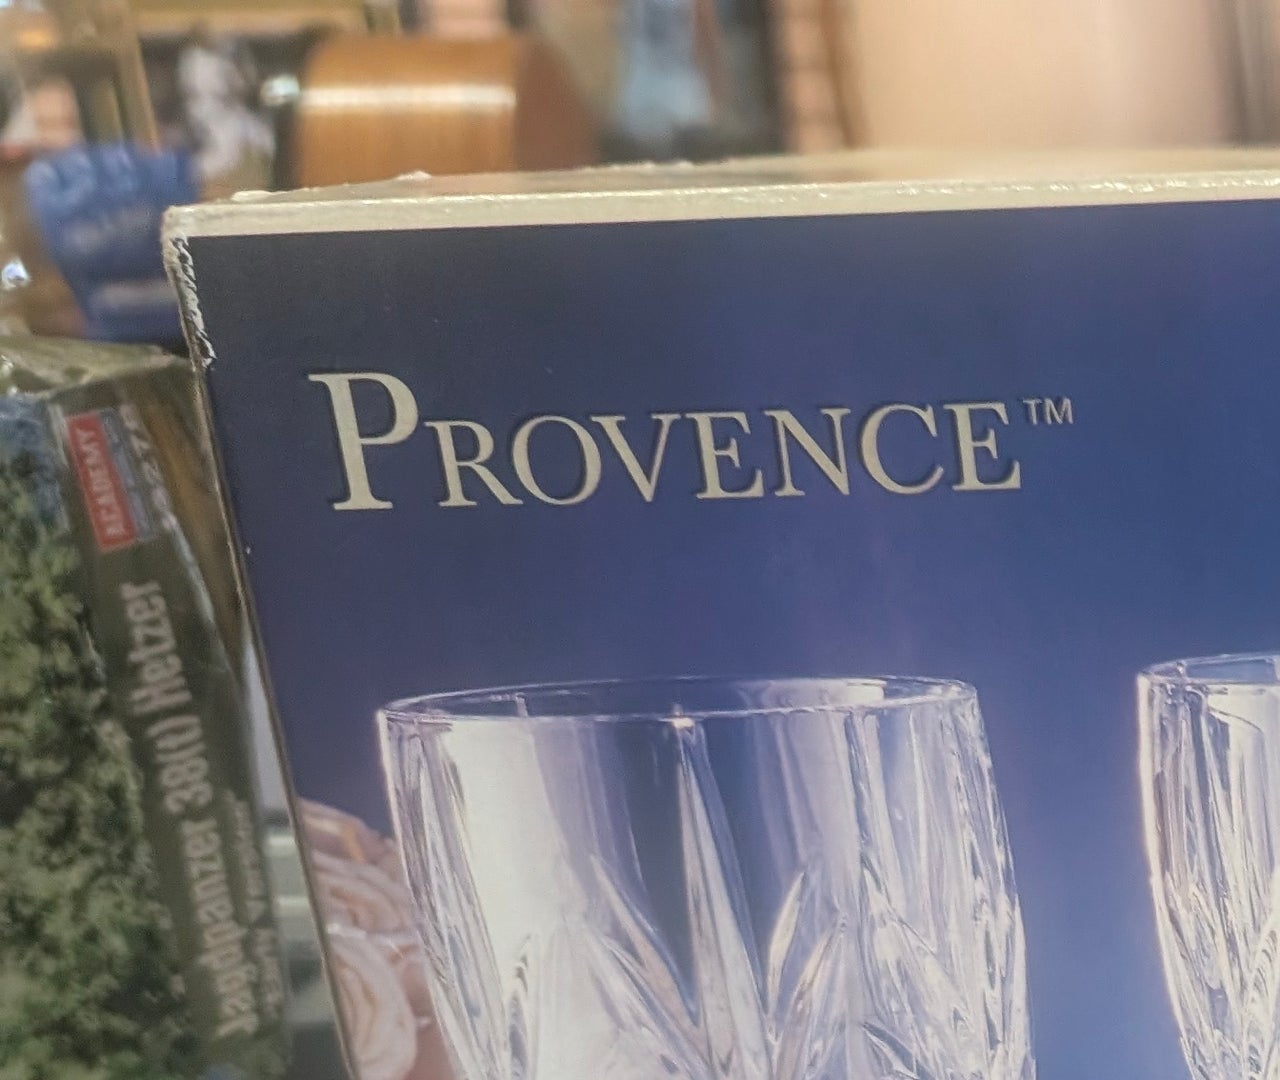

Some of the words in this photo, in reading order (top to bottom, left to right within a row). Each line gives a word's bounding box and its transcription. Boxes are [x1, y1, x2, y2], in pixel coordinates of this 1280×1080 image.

[308, 371, 1022, 511] PROVENCE
[119, 579, 194, 716] Hetzer
[147, 713, 214, 815] 38(t)
[181, 816, 260, 1037] Jagdpanzer
